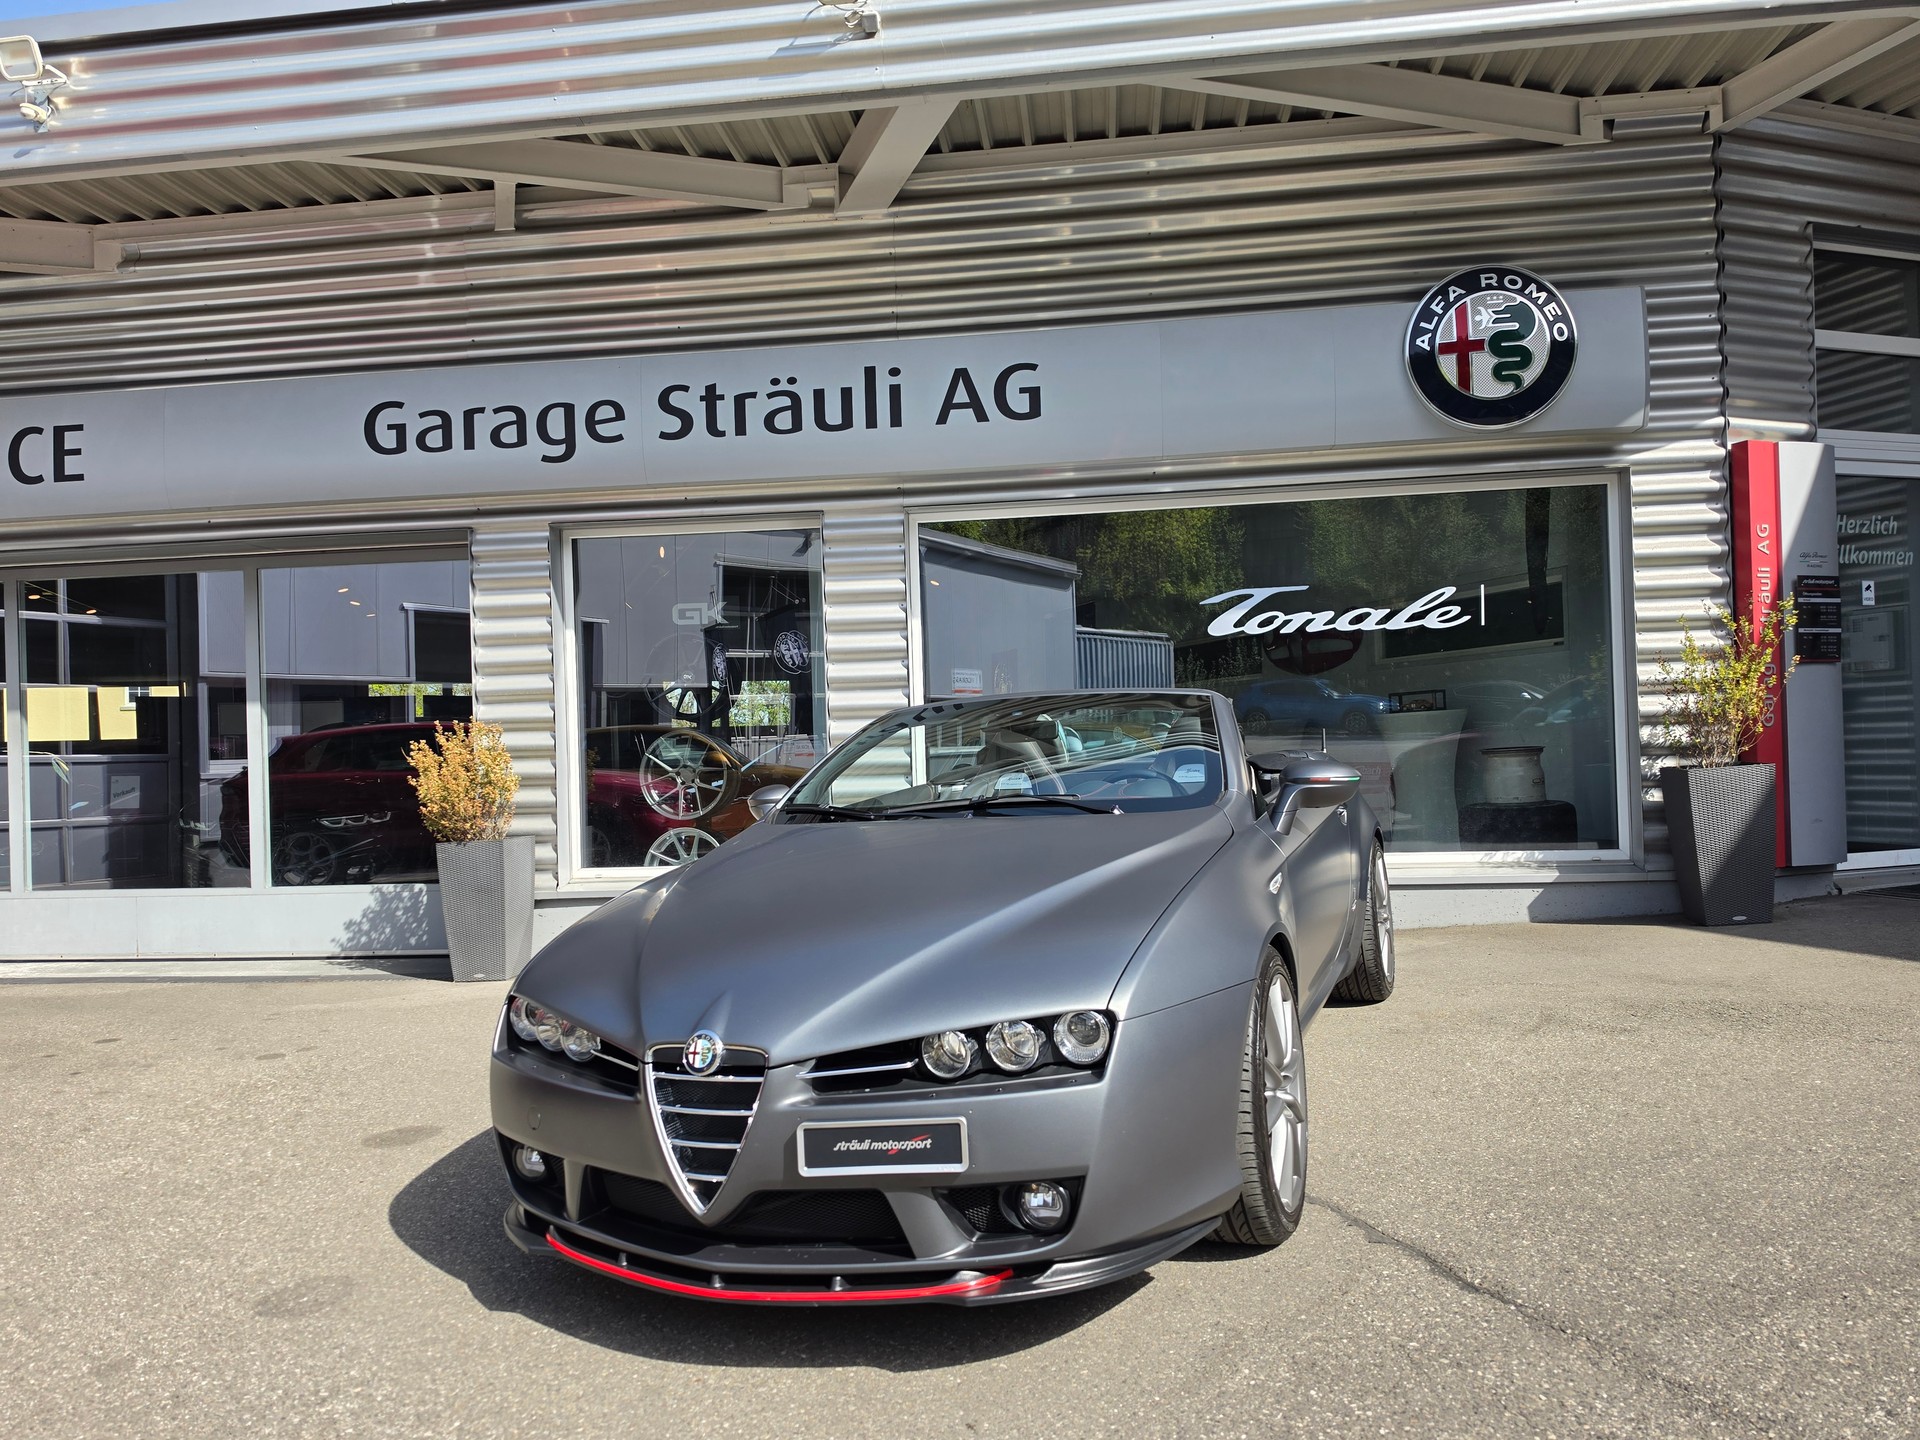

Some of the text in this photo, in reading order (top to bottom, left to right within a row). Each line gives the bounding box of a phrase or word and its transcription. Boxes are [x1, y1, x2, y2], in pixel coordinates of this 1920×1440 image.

[1416, 273, 1569, 351] ALFA ROMEO
[364, 363, 1042, 463] Garage Sträuli AG
[8, 424, 85, 485] CE
[1757, 523, 1770, 555] AG
[1836, 514, 1898, 535] Herzlich
[1837, 544, 1914, 566] llkommen
[1199, 585, 1472, 637] Tonale
[832, 1138, 932, 1151] sträuli motorsport
